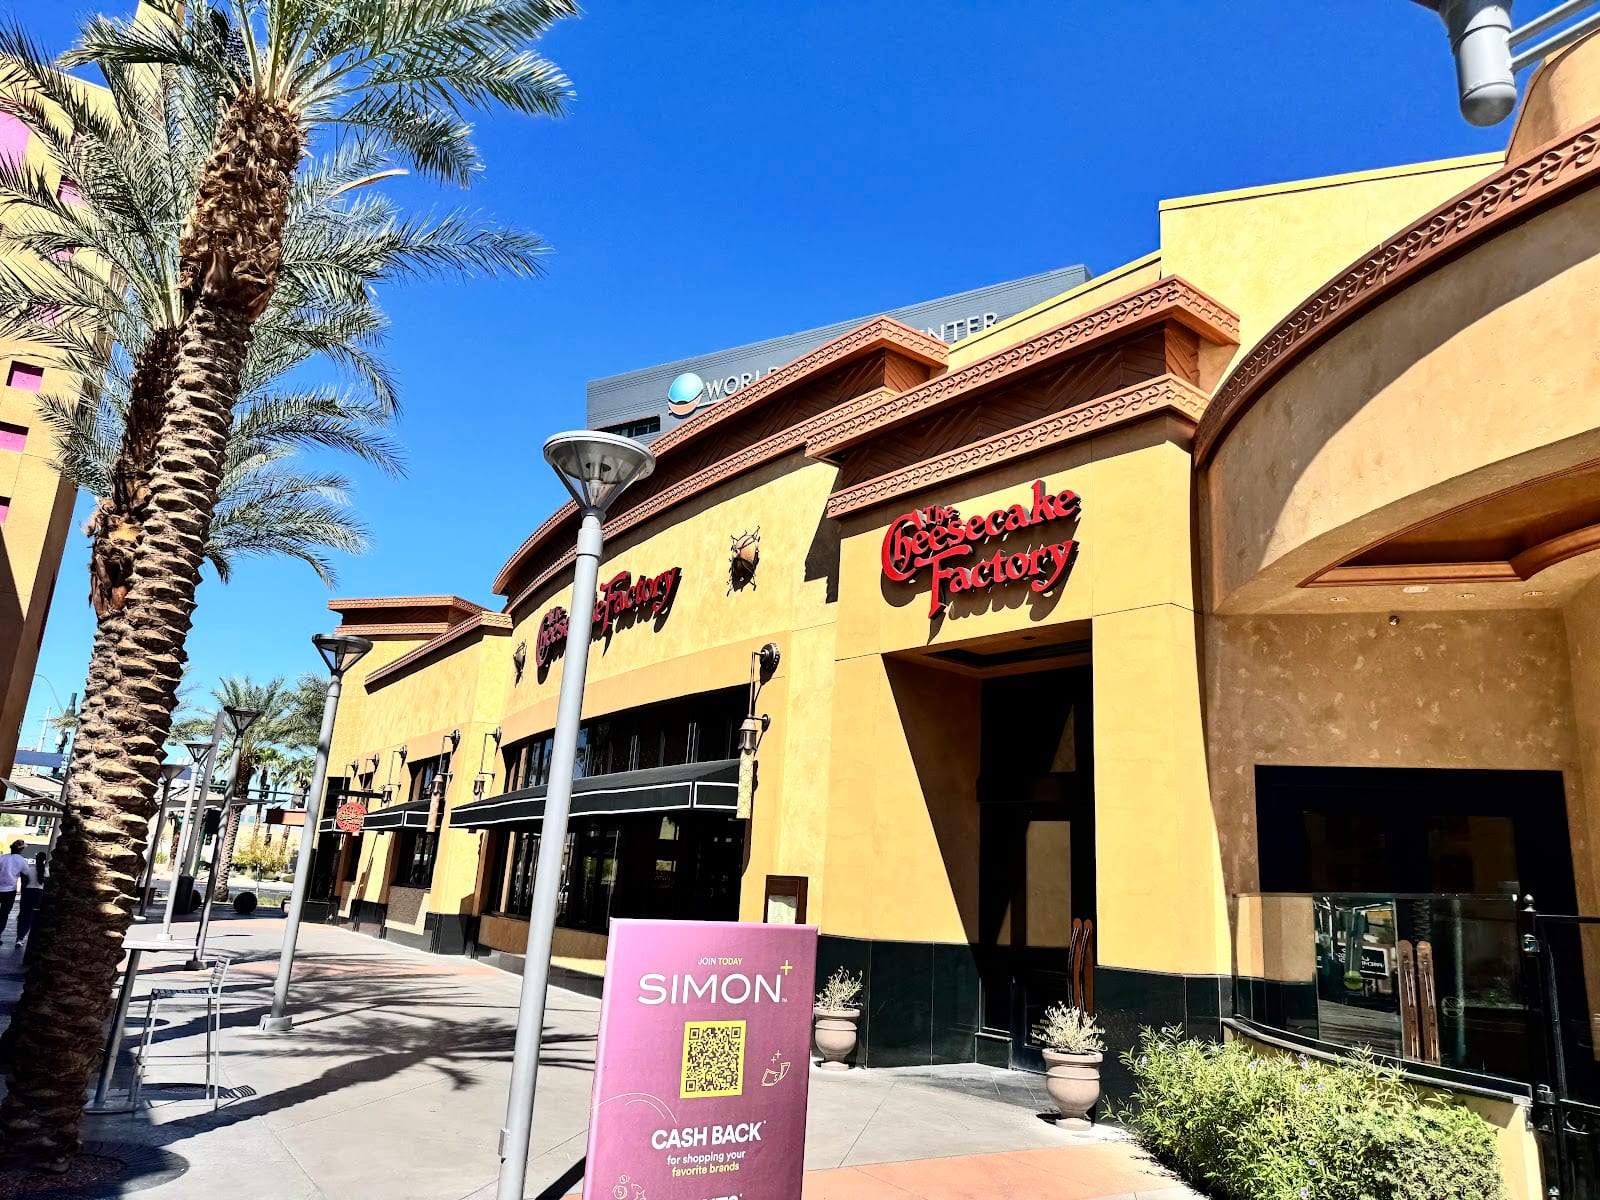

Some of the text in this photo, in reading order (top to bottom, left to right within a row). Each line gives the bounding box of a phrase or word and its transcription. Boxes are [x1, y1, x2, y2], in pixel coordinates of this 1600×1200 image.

[923, 504, 955, 524] The
[881, 479, 1079, 582] Cheesecake
[913, 540, 1077, 619] Factory
[600, 567, 679, 637] Factory
[697, 957, 743, 966] JOIN TODAY
[651, 1126, 707, 1150] CASH
[666, 1150, 746, 1166] for shopping your
[671, 1161, 740, 1177] favorite brands
